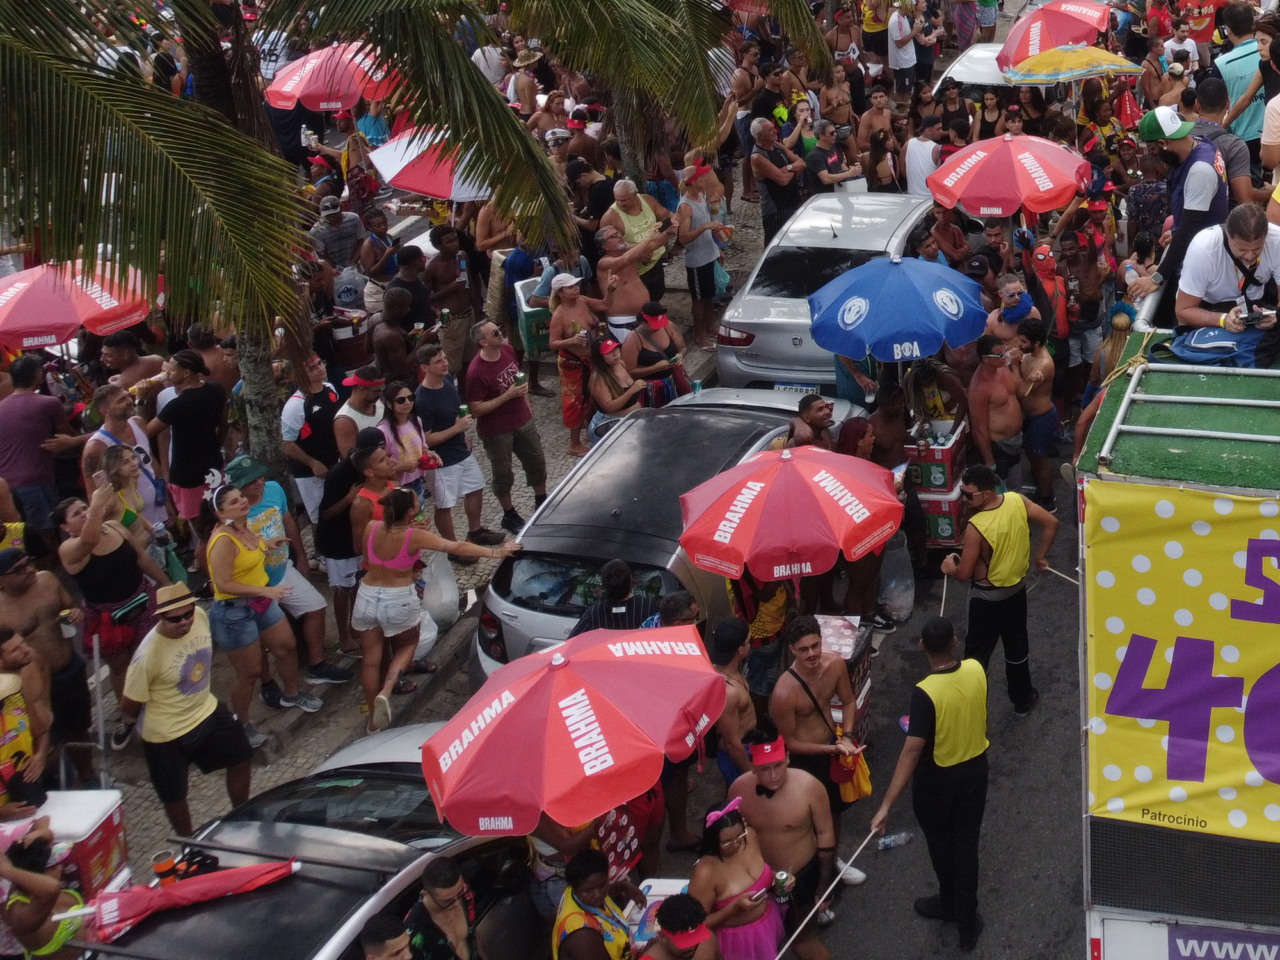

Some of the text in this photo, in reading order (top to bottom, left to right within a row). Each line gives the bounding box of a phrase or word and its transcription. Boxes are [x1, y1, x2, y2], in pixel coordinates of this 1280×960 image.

[1061, 3, 1101, 18] BRAHMA
[1028, 21, 1042, 56] BRAHMA
[943, 150, 988, 188] BRAHMA
[1017, 152, 1055, 192] BRAHMA
[980, 207, 1002, 215] BRAHMA
[23, 335, 56, 347] BRAHMA
[713, 481, 765, 544] BRAHMA
[812, 469, 871, 524] BRAHMA
[607, 641, 702, 658] BRAHMA
[438, 689, 516, 774] BRAHMA
[557, 688, 615, 777] BRAHMA
[478, 816, 514, 831] BRAHMA
